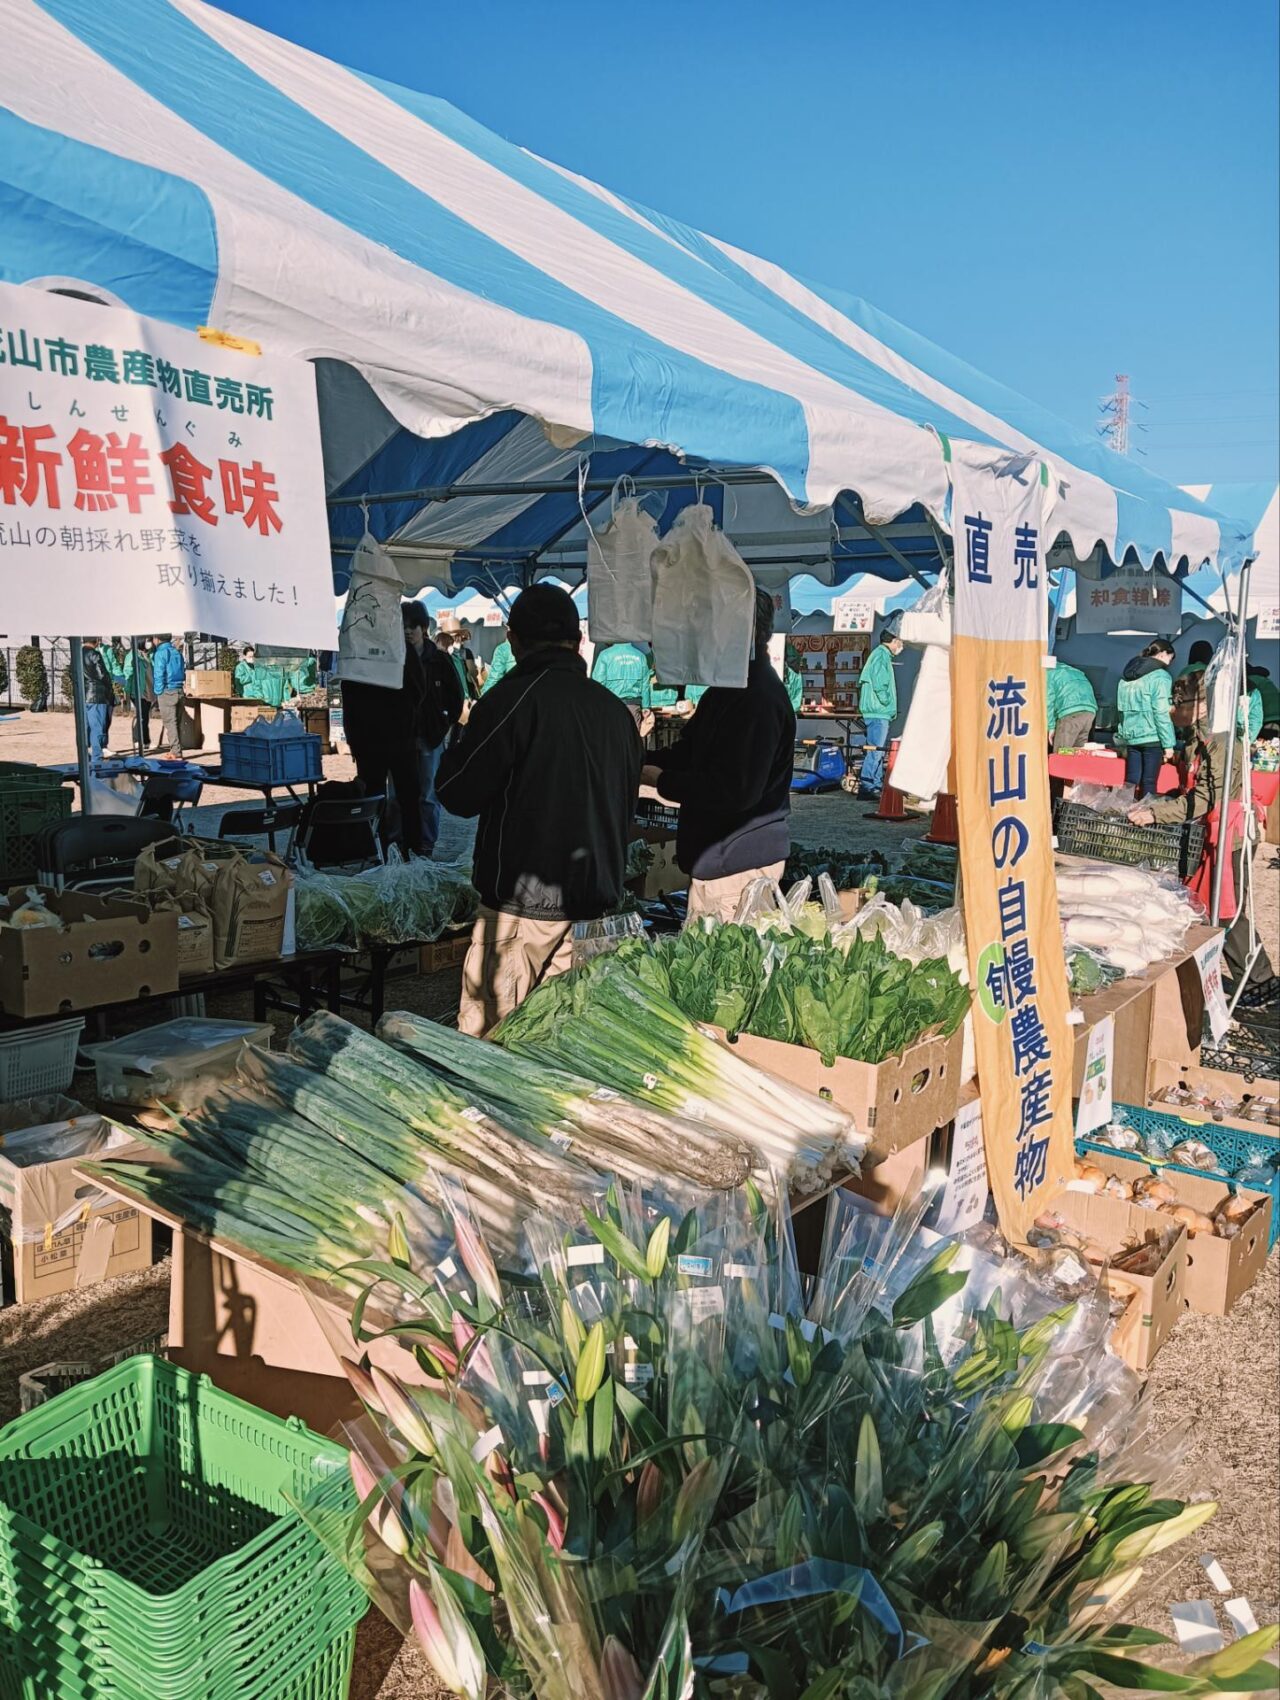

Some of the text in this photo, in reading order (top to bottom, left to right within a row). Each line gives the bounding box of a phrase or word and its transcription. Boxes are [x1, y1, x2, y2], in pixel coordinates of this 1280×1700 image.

[0, 328, 274, 421] 山市農産物直売所
